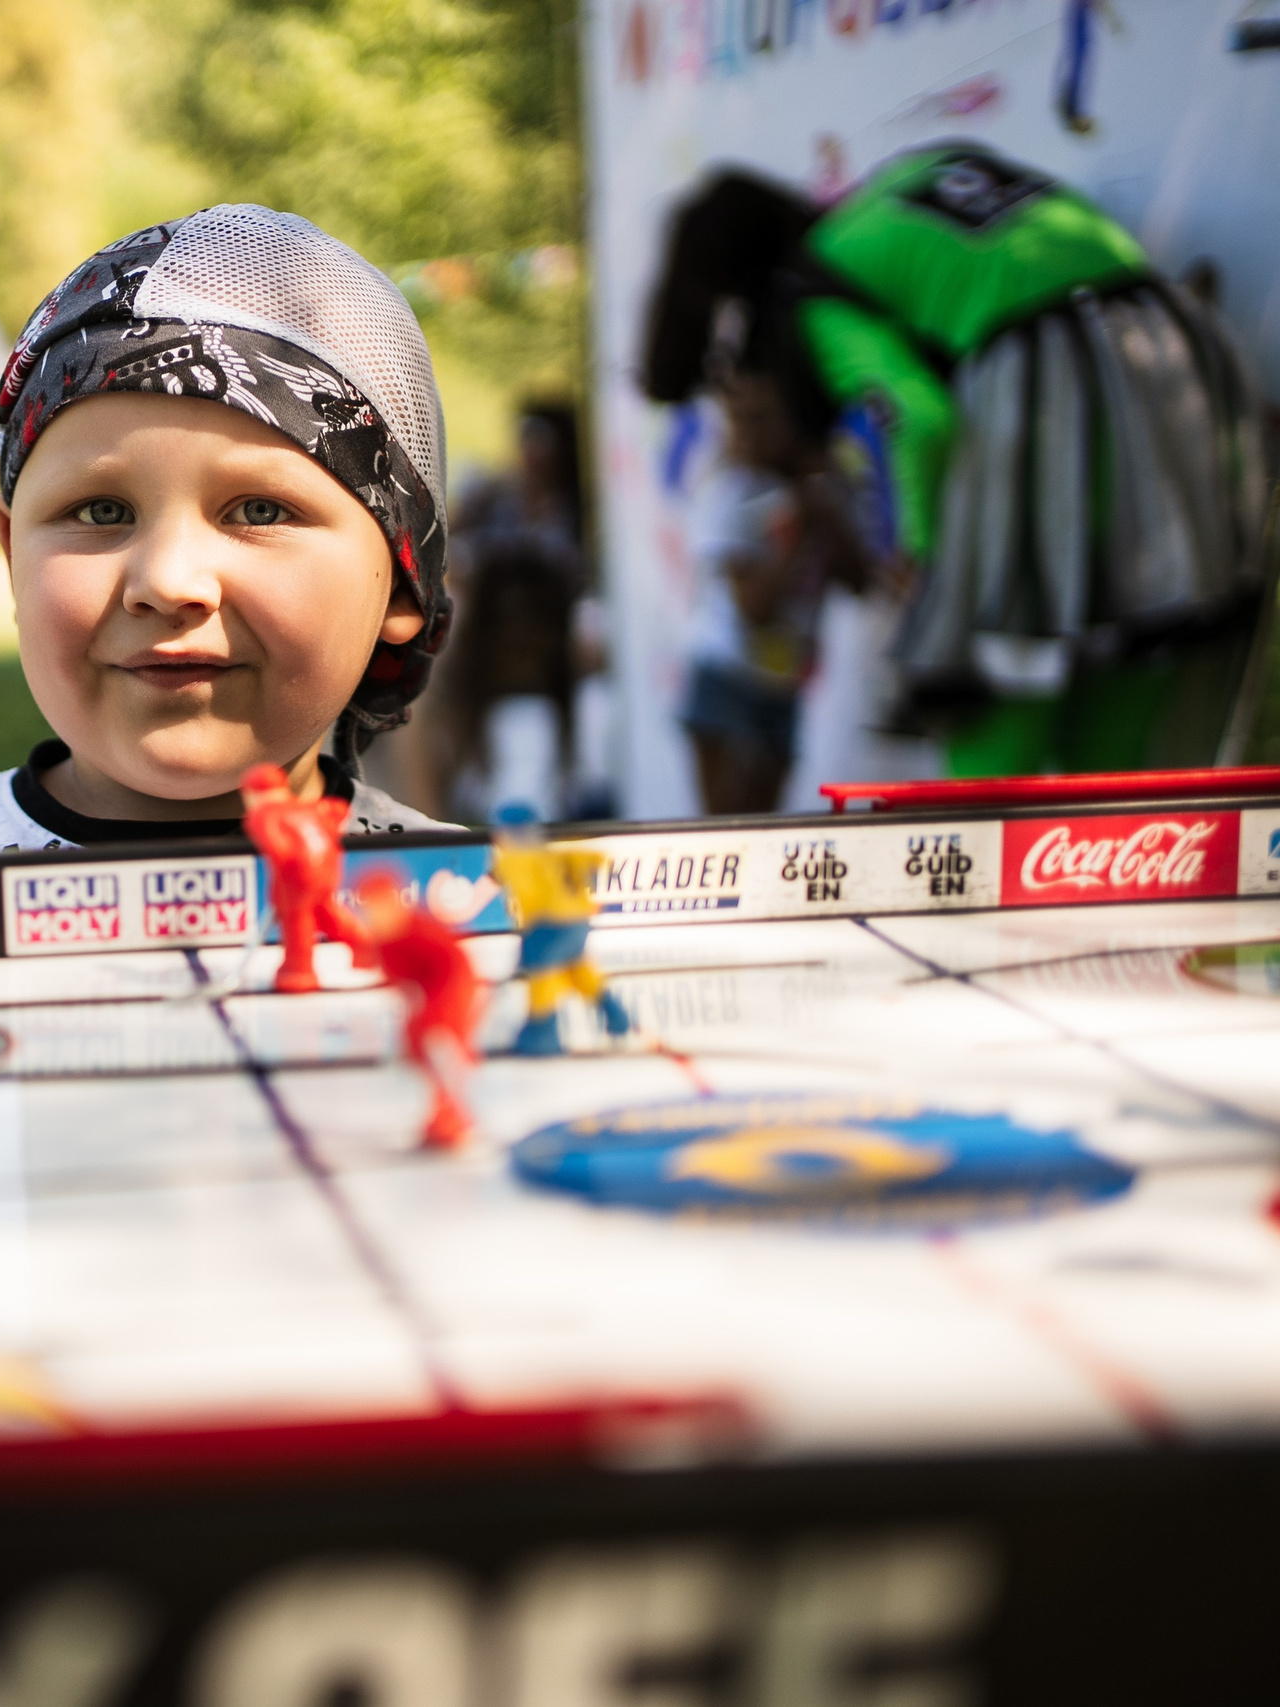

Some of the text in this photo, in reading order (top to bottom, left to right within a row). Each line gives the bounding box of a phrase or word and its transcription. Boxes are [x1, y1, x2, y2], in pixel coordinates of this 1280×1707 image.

[784, 840, 836, 860] UTE
[907, 834, 961, 855] UTE
[1020, 821, 1218, 889] Coca-Cola
[592, 847, 740, 893] KLÄDER
[782, 860, 847, 881] GUID
[905, 854, 972, 876] GUID
[18, 876, 117, 910] LIQUI
[146, 870, 244, 904] LIQUI
[806, 881, 841, 901] EN
[930, 875, 965, 896] EN
[19, 908, 119, 941] MOLY
[147, 901, 246, 936] MOLY
